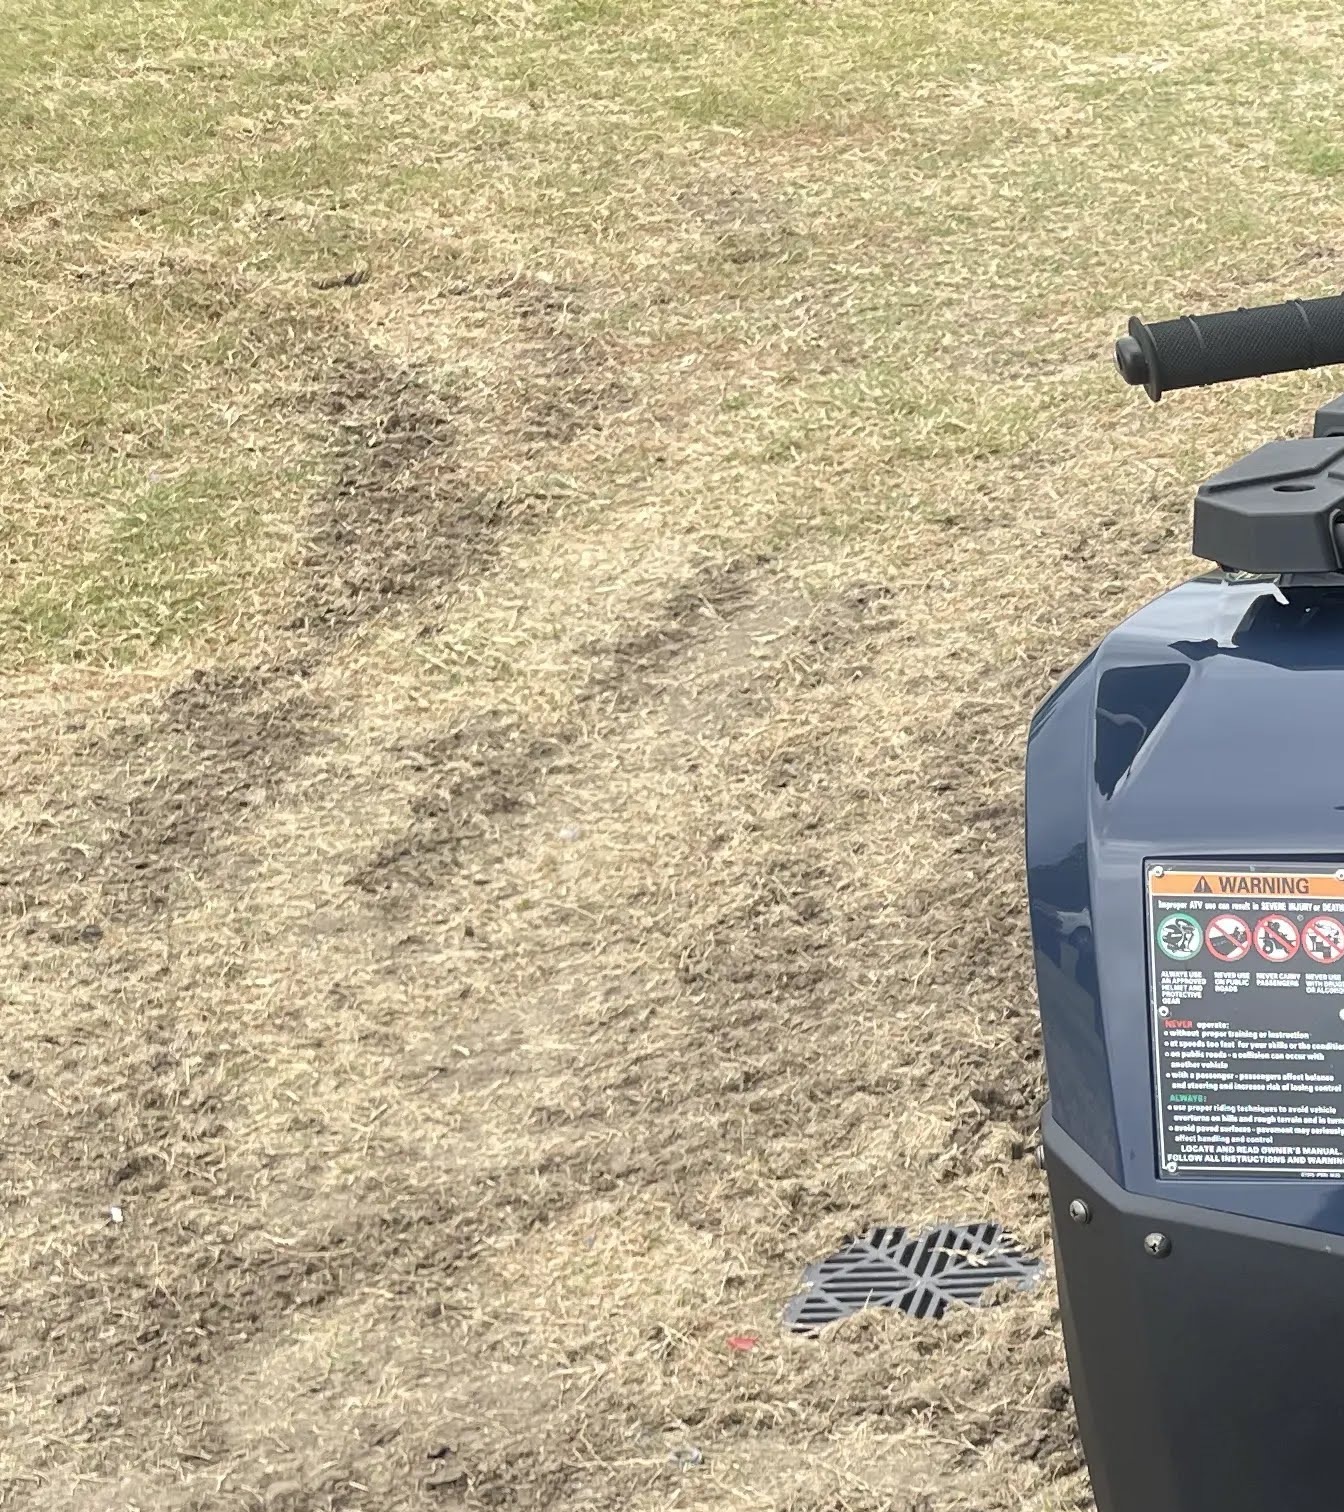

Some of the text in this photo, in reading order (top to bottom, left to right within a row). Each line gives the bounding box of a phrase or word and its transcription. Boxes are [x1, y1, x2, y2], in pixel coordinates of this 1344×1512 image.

[1219, 876, 1310, 894] WARNING
[1165, 1020, 1192, 1028] NEVER
[1169, 1029, 1199, 1037] without
[1228, 1030, 1258, 1039] training
[1268, 1031, 1309, 1039] instruction
[1216, 1145, 1235, 1153] AND
[1167, 1154, 1203, 1162] FOLLOW
[1204, 1154, 1220, 1162] ALL
[1221, 1155, 1286, 1163] INSTRUCTIONS
[1287, 1156, 1306, 1164] AND
